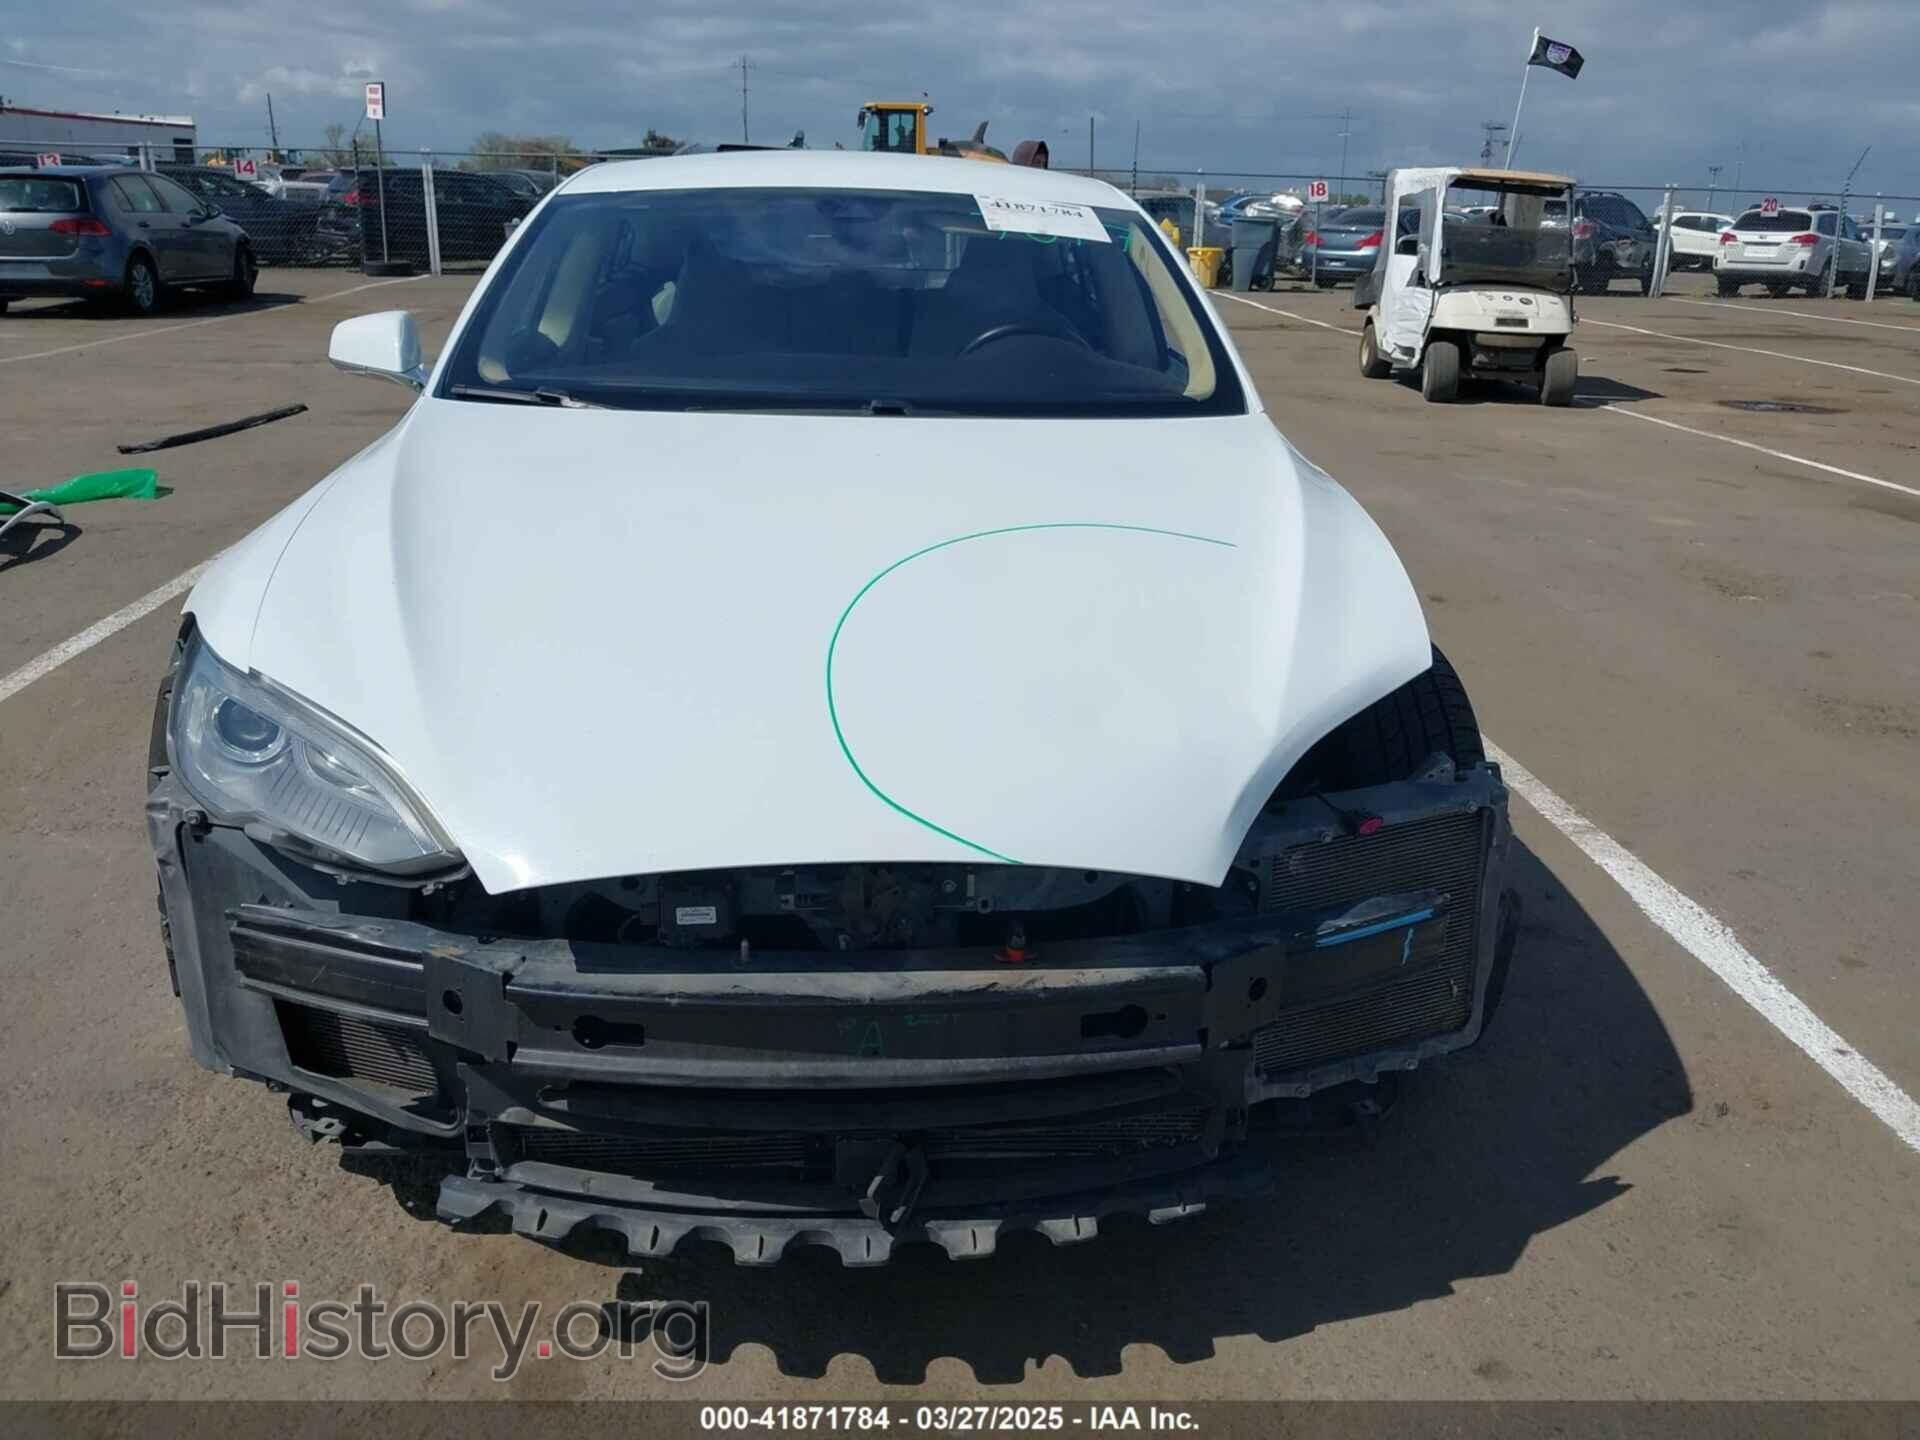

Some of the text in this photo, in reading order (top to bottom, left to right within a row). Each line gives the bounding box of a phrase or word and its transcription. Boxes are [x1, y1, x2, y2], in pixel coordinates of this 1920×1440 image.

[236, 159, 255, 174] 14
[1311, 182, 1326, 197] 18
[1763, 198, 1777, 212] 20
